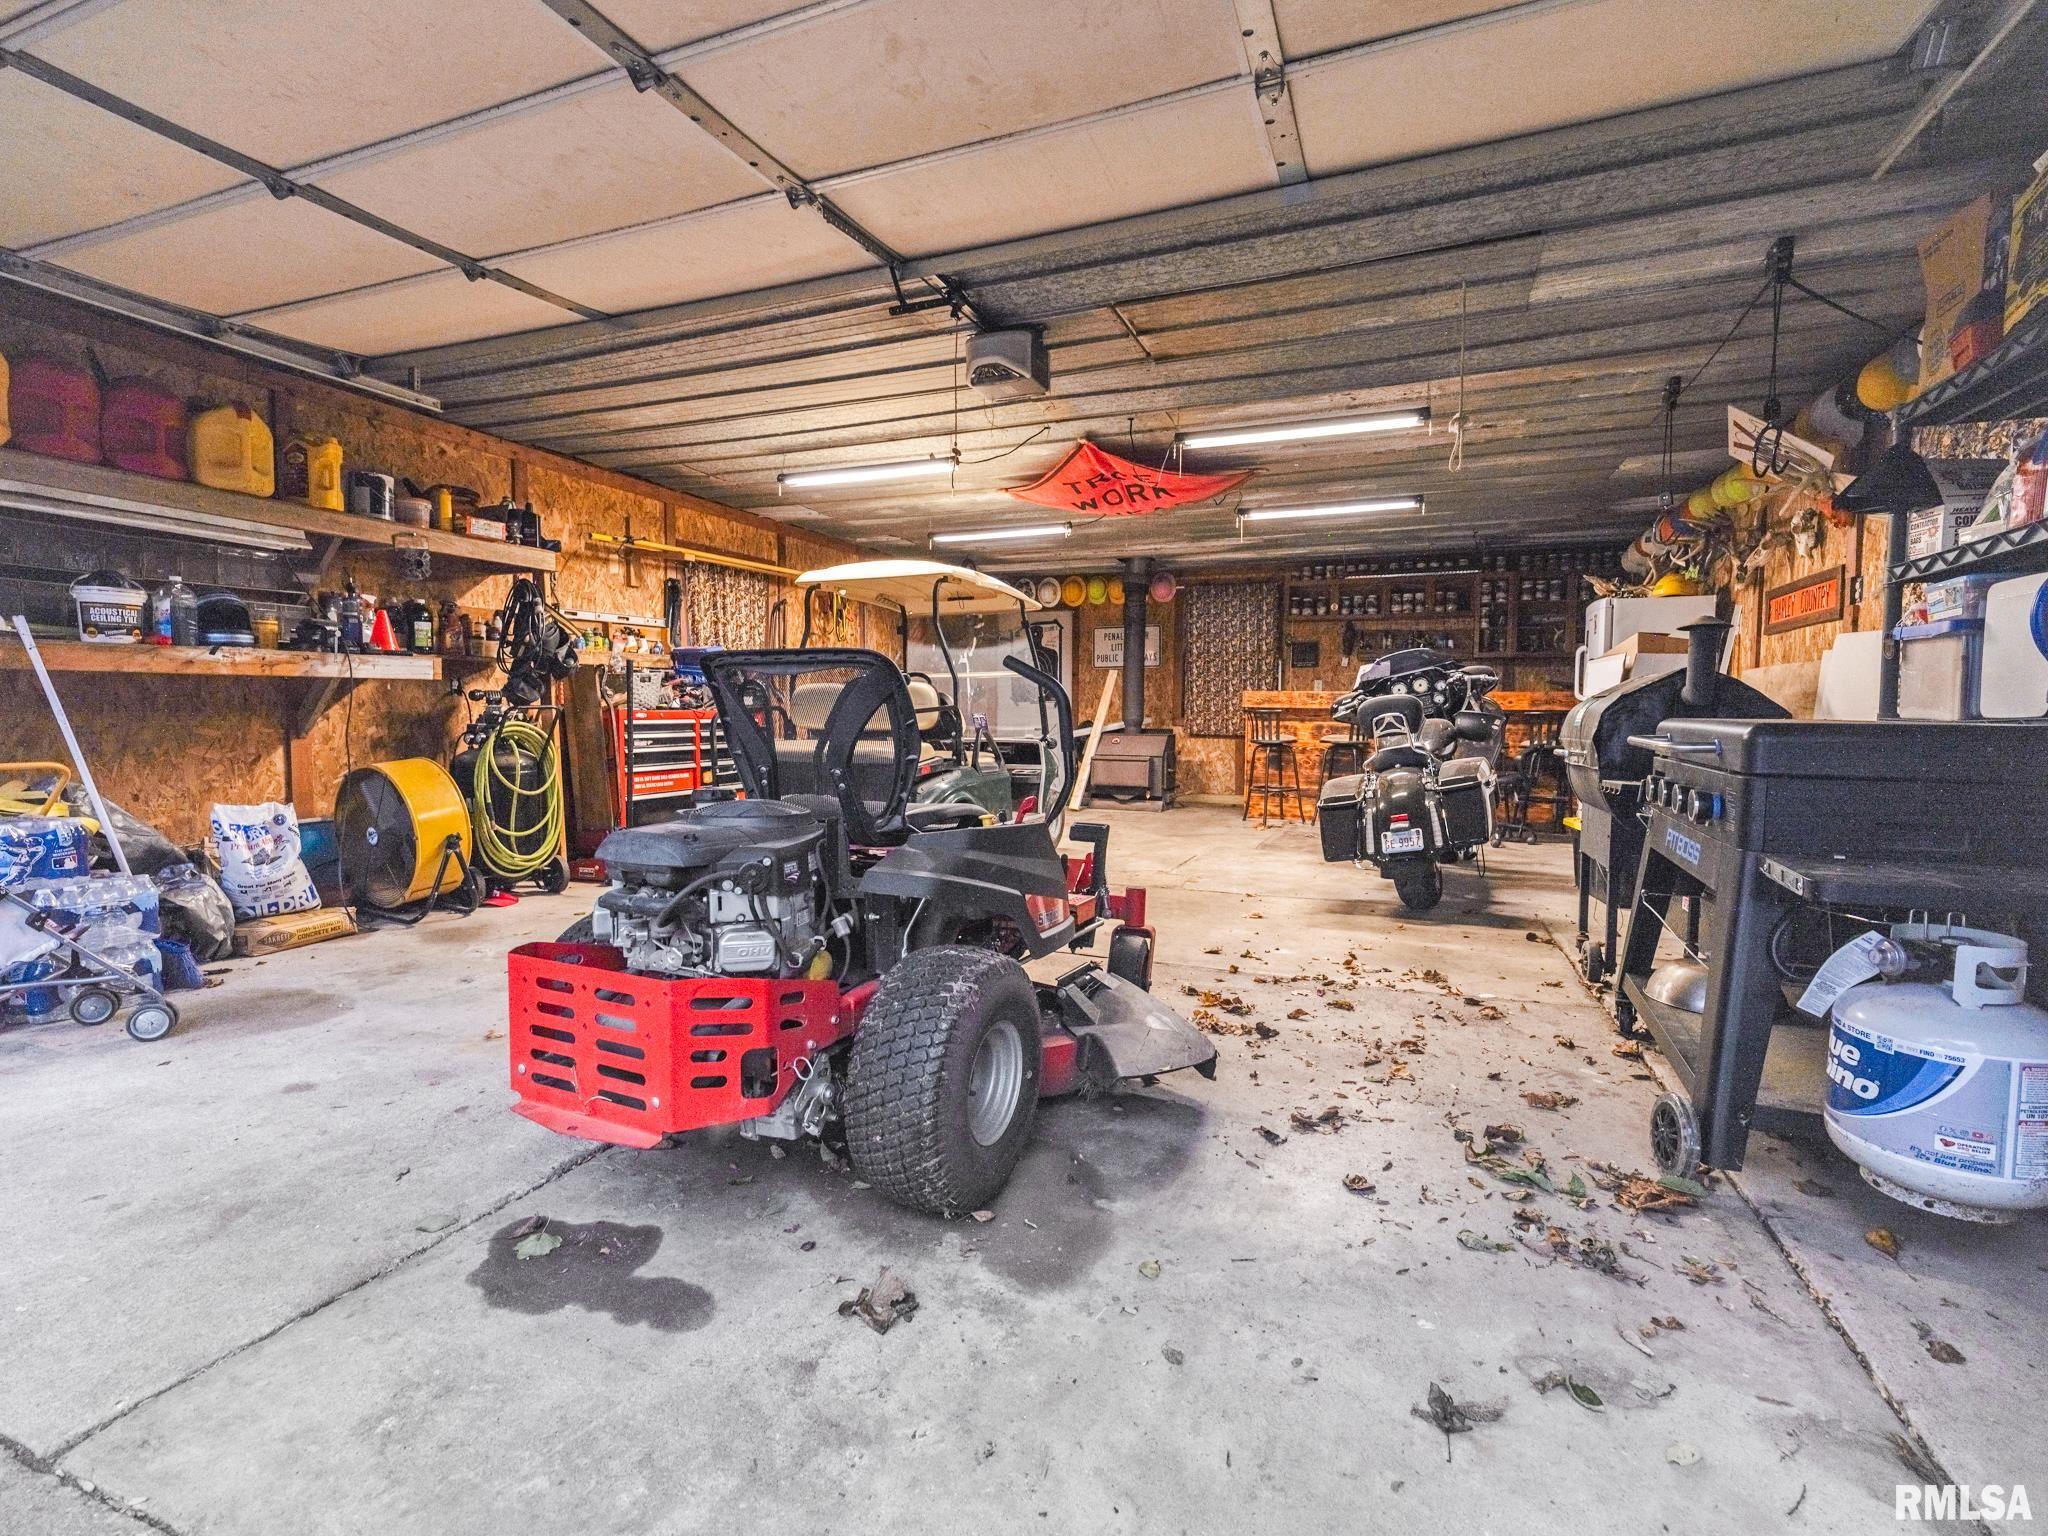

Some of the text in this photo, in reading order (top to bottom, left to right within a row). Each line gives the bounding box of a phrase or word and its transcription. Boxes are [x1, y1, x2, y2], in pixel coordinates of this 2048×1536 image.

[1774, 583, 1831, 621] HARLEY COUNTRY
[89, 606, 138, 617] ACOUSTICAL
[90, 614, 122, 623] CEILING
[1096, 654, 1119, 663] PUBLIC
[267, 878, 282, 886] Many
[297, 928, 329, 940] CONCRETE
[1847, 1025, 1872, 1040] STORE
[1919, 1049, 1935, 1058] FIND
[1829, 1034, 1861, 1066] ue
[1957, 1142, 1991, 1152] OPERATION
[1940, 1152, 1957, 1161] just
[1934, 1157, 1957, 1168] Blue
